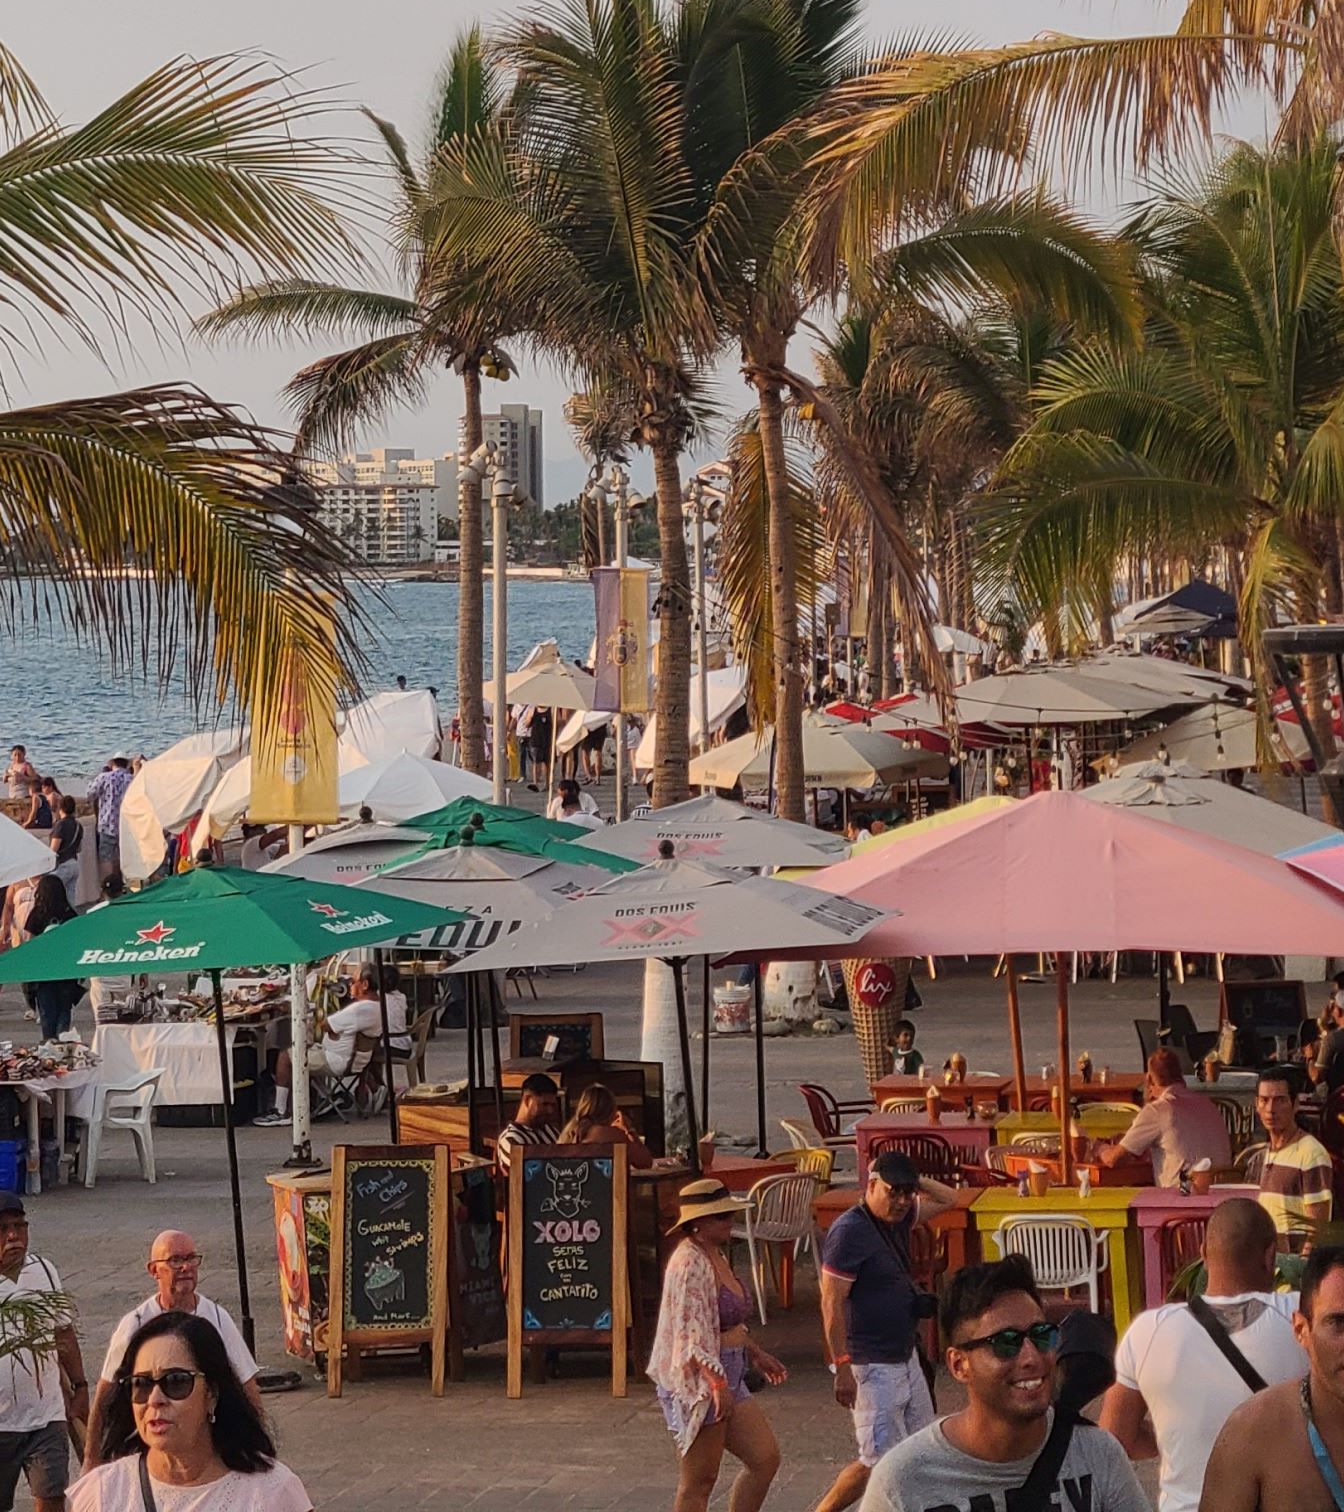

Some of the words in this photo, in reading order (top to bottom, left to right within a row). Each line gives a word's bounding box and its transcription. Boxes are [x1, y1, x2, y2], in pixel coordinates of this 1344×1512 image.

[615, 907, 645, 917] DOS
[77, 944, 202, 965] Heineken
[859, 968, 893, 1003] lix
[357, 1179, 381, 1198] Fish
[379, 1179, 408, 1202] Chips
[532, 1219, 601, 1244] XOLO
